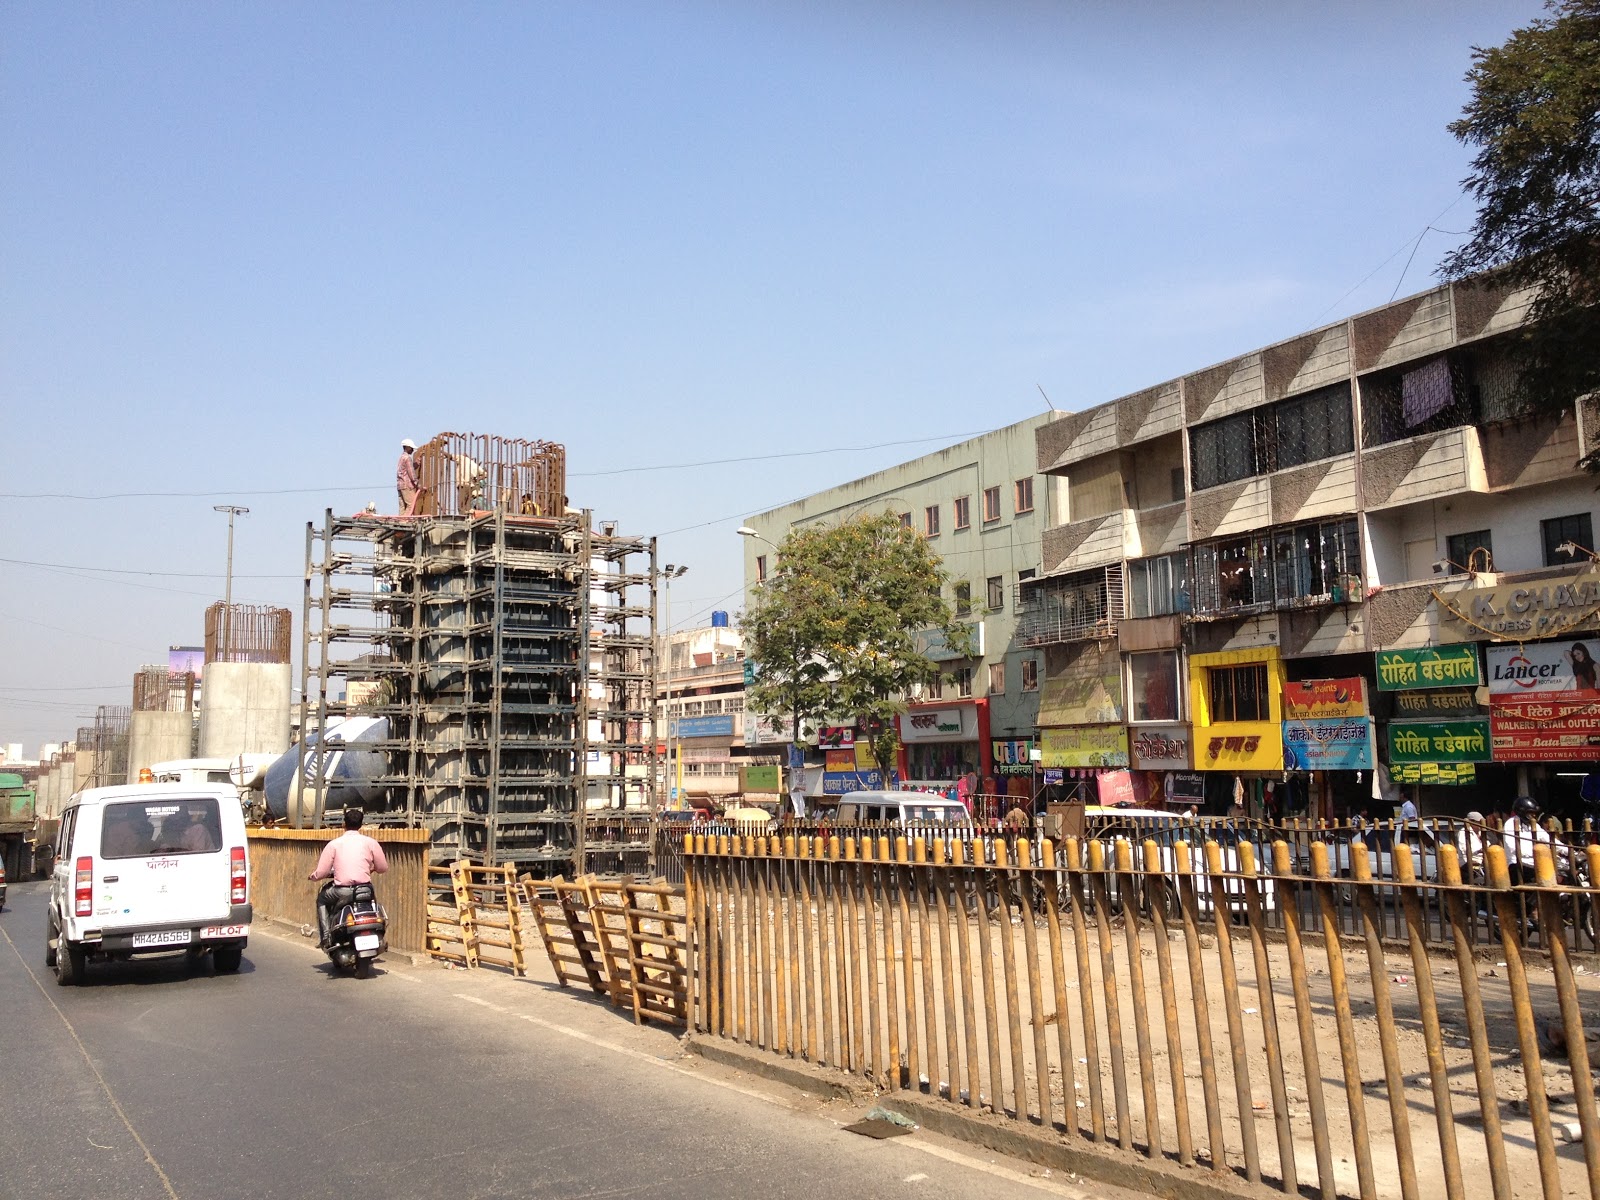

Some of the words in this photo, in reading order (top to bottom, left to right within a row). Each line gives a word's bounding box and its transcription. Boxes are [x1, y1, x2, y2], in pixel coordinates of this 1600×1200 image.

[1380, 656, 1417, 685] रोहित
[1420, 648, 1475, 680] वडेवाले
[1493, 664, 1560, 680] Lancer
[1398, 690, 1428, 711] रोहित
[1496, 720, 1535, 731] WALKERS
[1537, 720, 1566, 729] RETAIL
[1208, 736, 1262, 760] कुणाल
[1394, 731, 1430, 755] रोहित
[1433, 728, 1485, 753] वडेवाले
[1532, 738, 1559, 747] Bata
[134, 931, 190, 945] MH42A6569
[207, 926, 243, 936] PILOT
